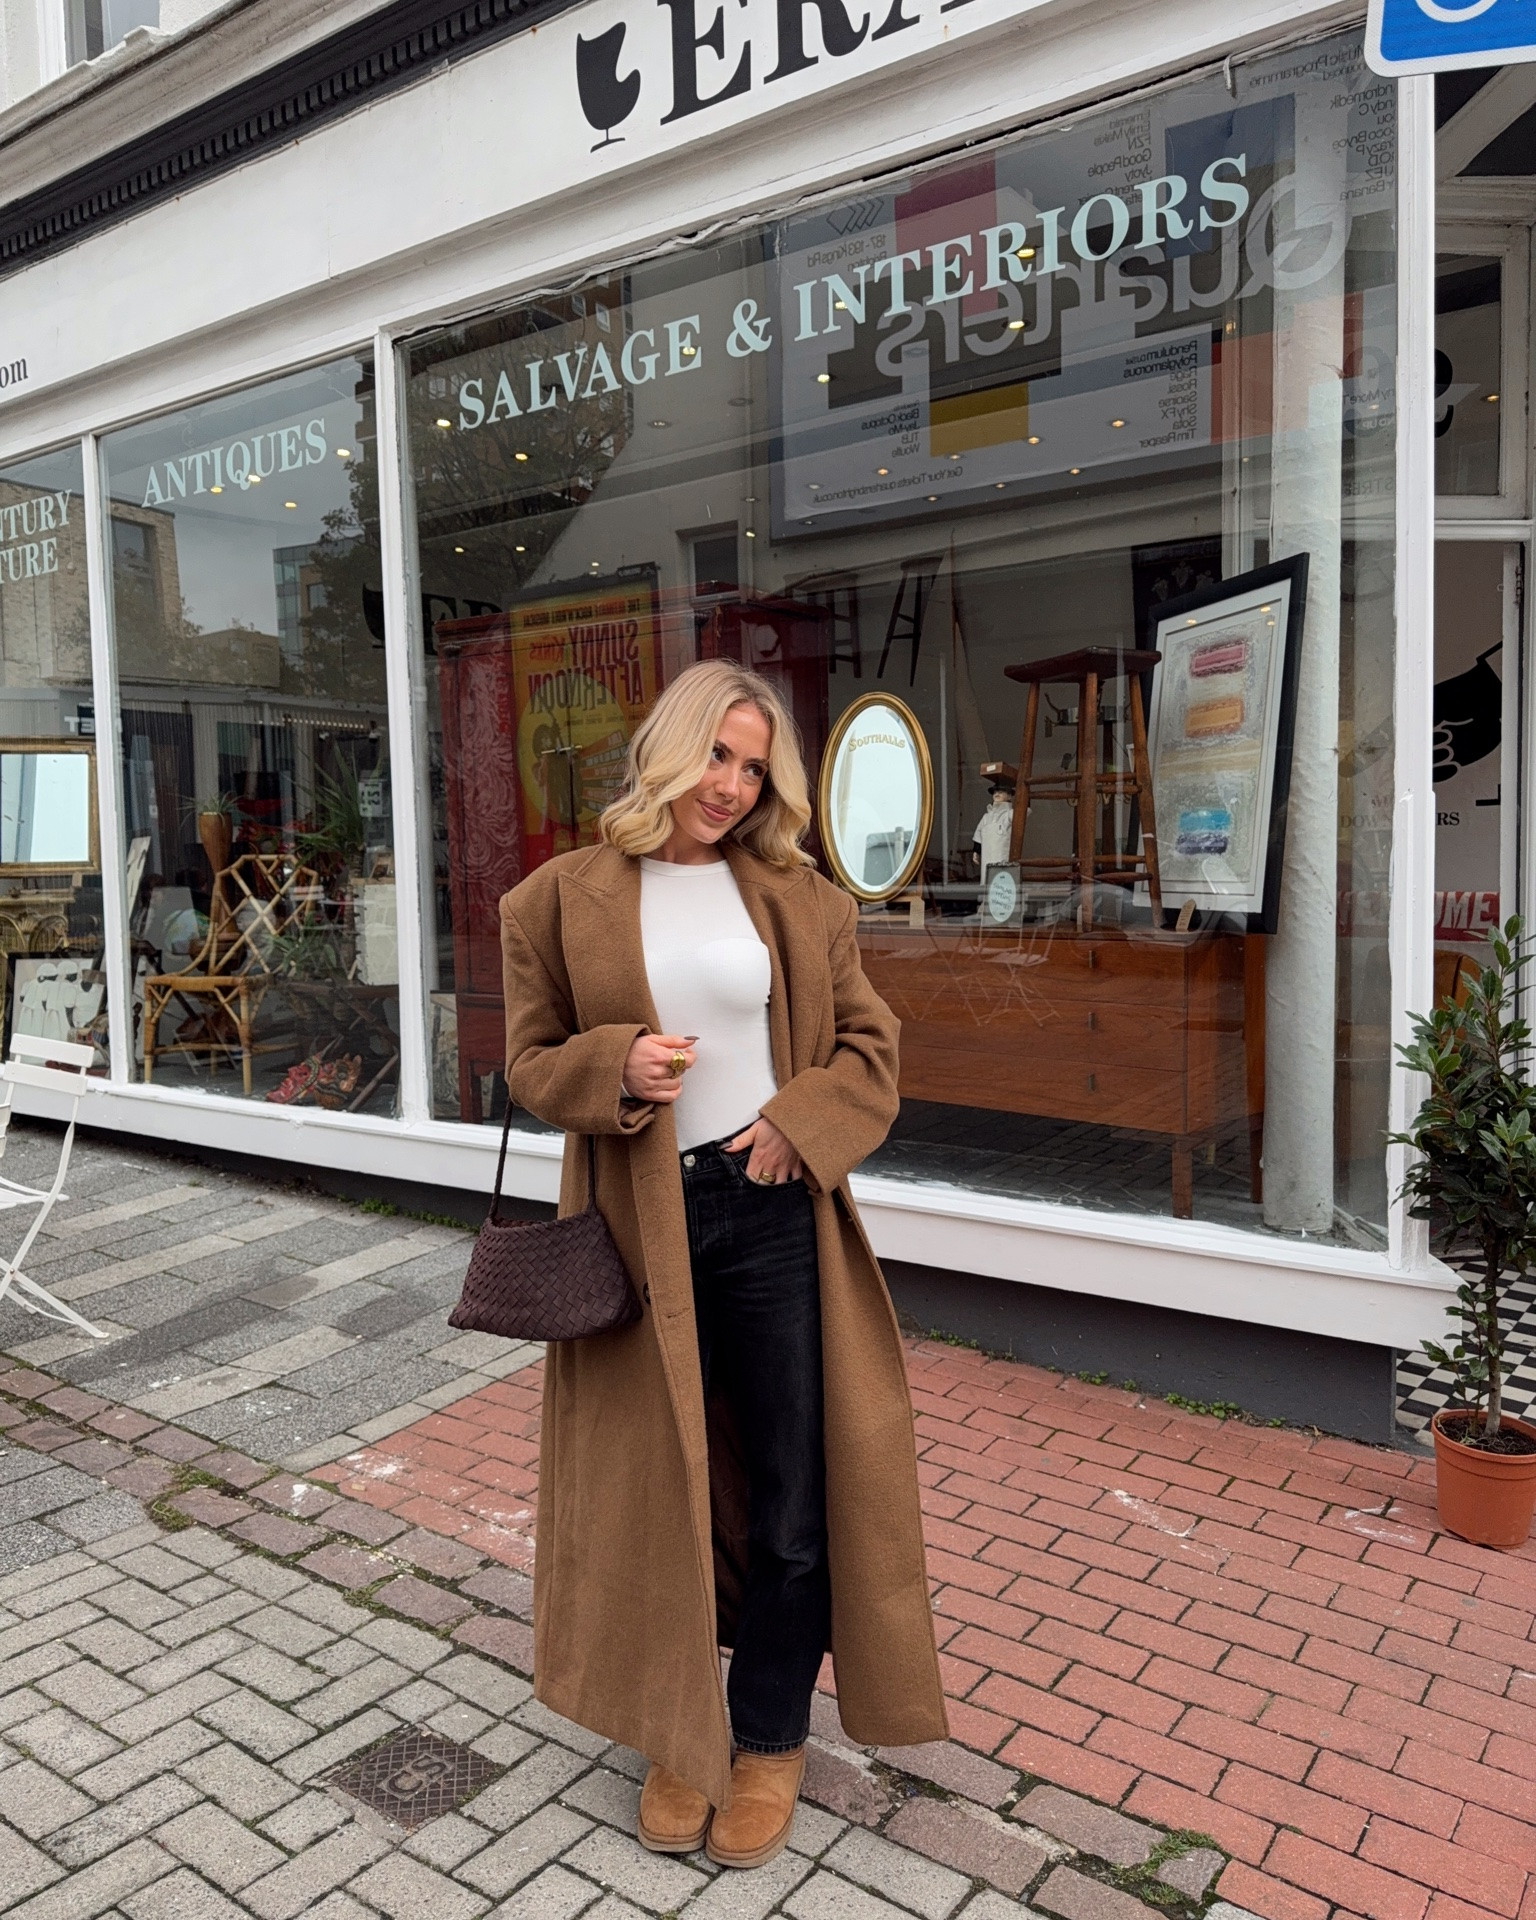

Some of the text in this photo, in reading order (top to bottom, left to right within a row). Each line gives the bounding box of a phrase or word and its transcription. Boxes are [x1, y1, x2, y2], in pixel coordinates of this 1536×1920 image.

[460, 153, 1251, 430] SALVAGE & INTERIORS
[141, 418, 327, 508] ANTIQUES
[0, 489, 73, 543] TURY
